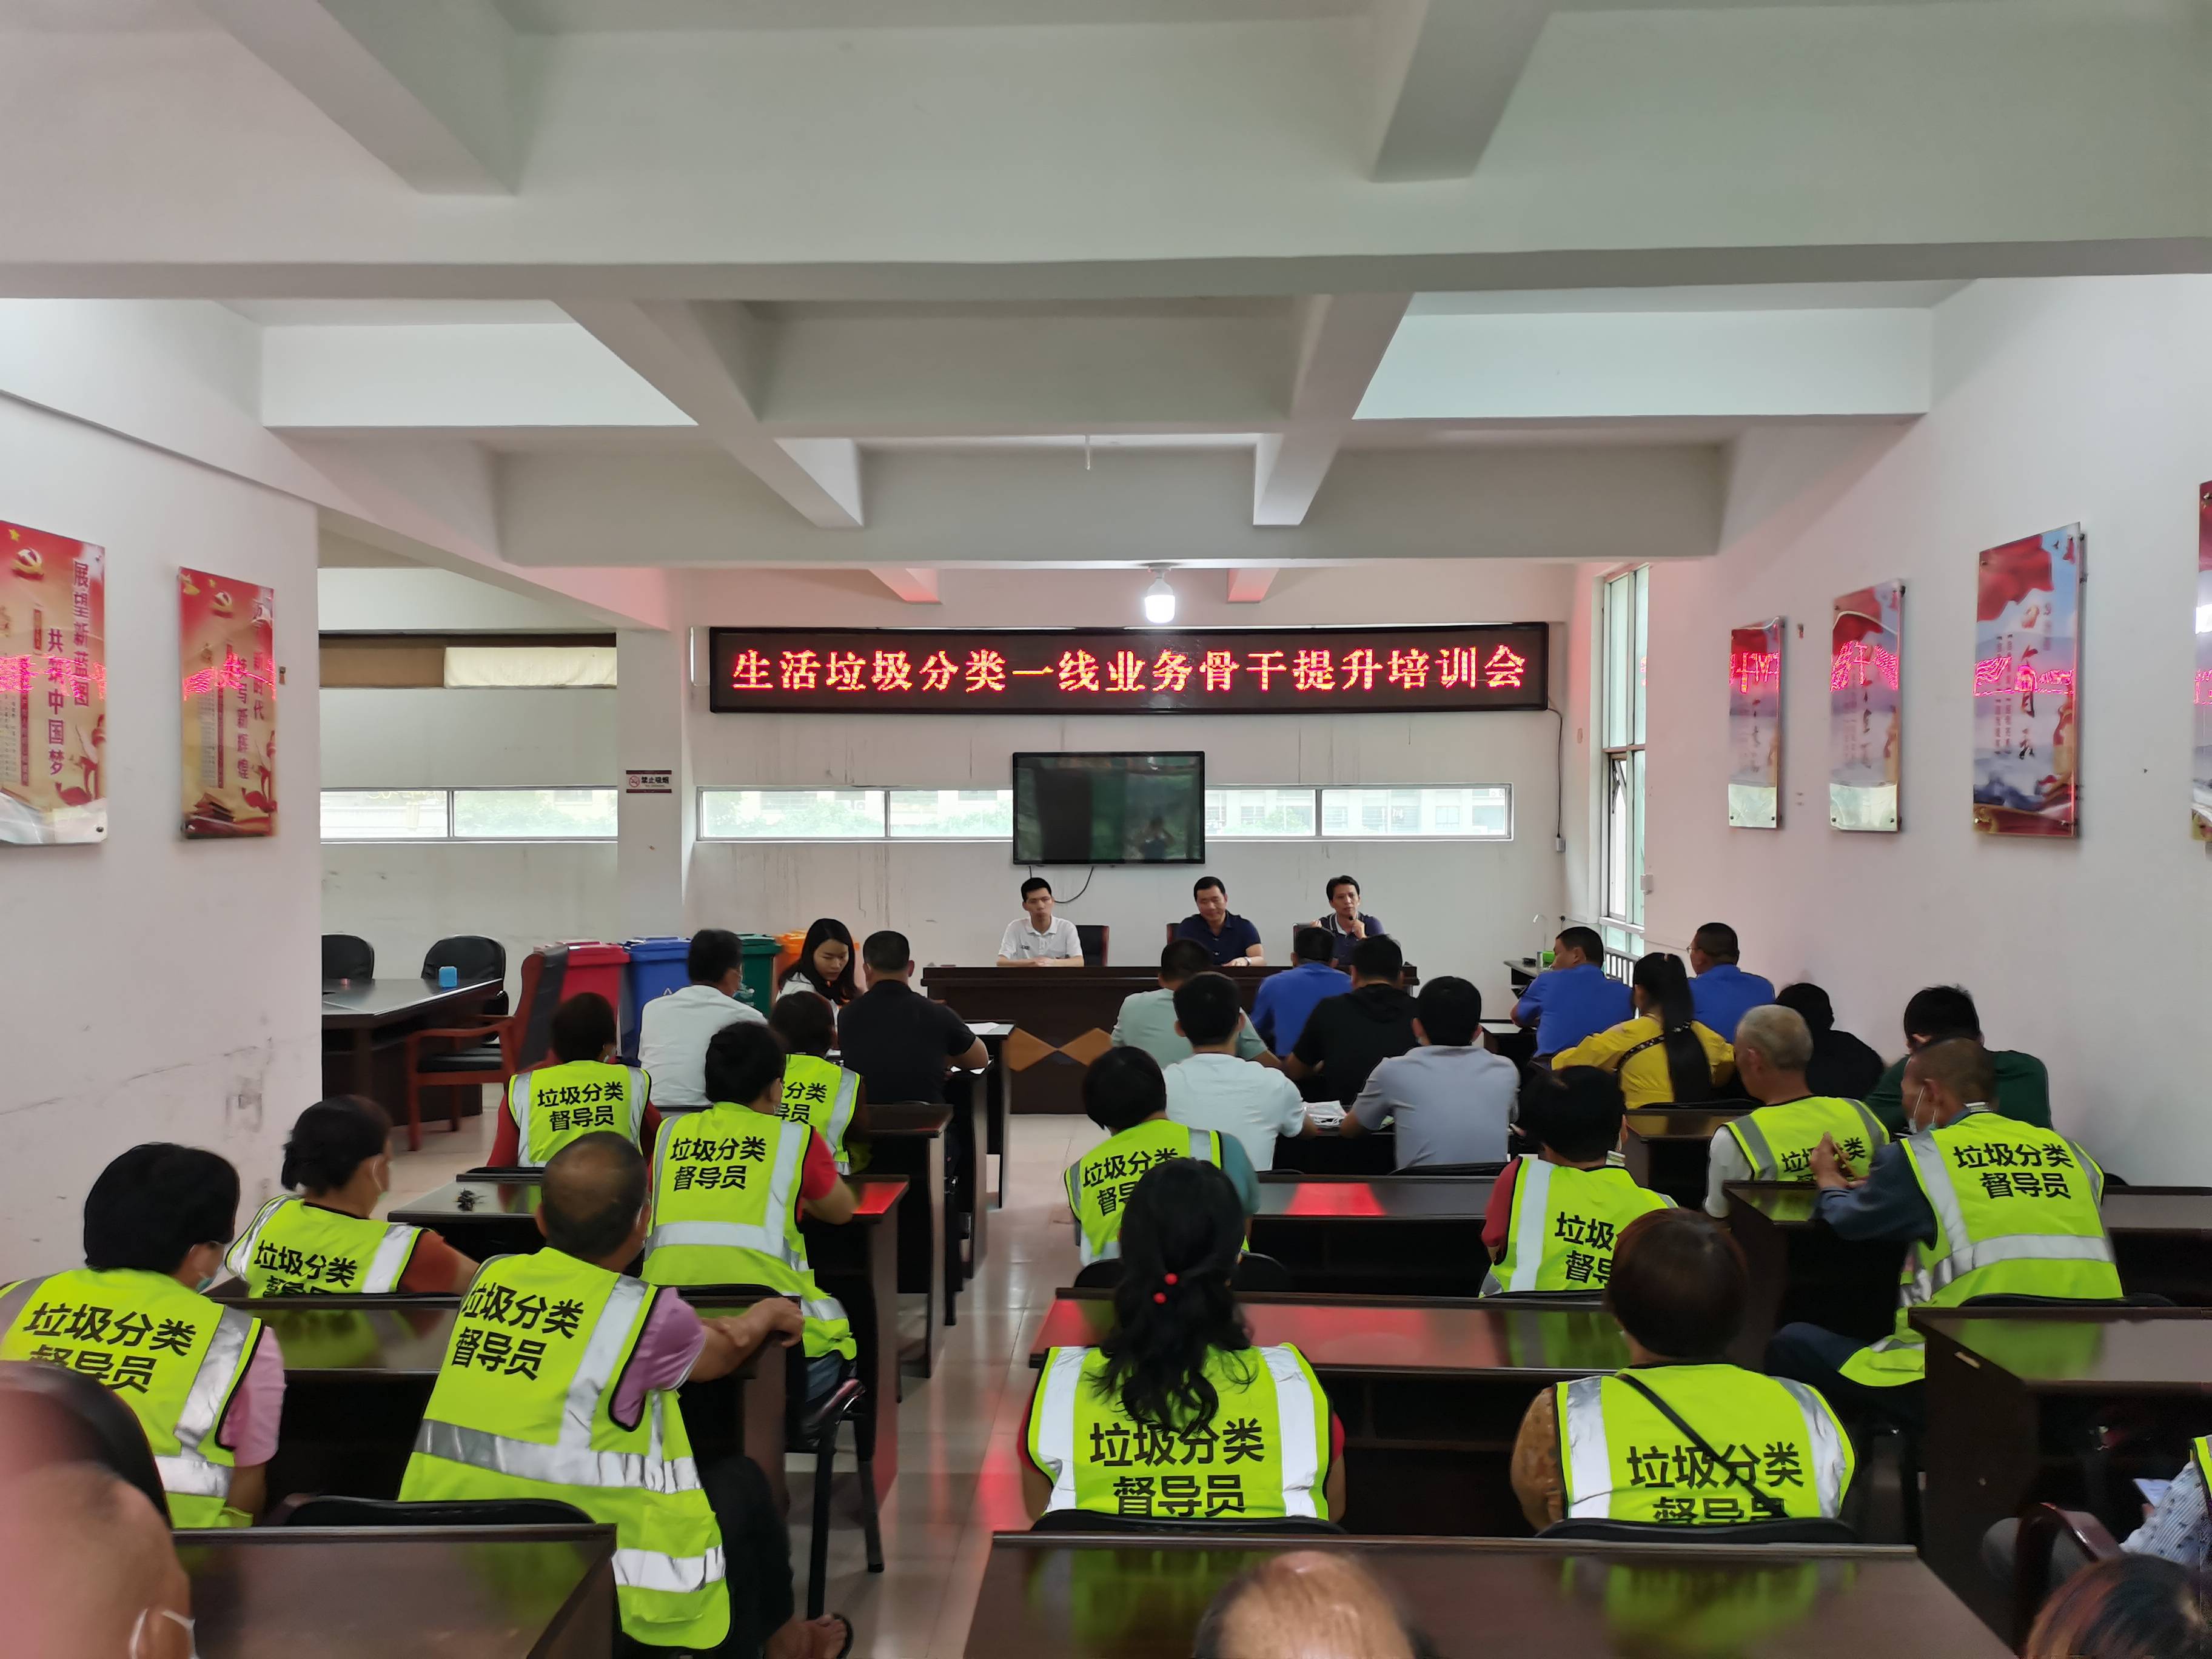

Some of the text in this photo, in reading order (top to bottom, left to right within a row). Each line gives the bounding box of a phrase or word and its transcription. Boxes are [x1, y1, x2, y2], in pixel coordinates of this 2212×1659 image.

[732, 645, 1526, 692] 生活垃圾分类一线业务骨干提升培训会
[537, 1081, 624, 1107] 垃圾分类
[783, 1081, 827, 1104] 分类
[549, 1105, 615, 1131] 督导员
[774, 1103, 811, 1125] 导员
[669, 1135, 767, 1162] 垃圾分类
[1780, 1137, 1866, 1173] 垃类
[1953, 1142, 2074, 1168] 垃圾分类
[673, 1165, 747, 1191] 督导员
[1980, 1172, 2071, 1199] 督导员
[1096, 1181, 1138, 1217] 督导
[1554, 1212, 1615, 1252] 垃圾
[253, 1239, 359, 1288] 垃圾分类
[1565, 1250, 1614, 1285] 督导
[462, 1282, 585, 1339] 垃圾分类
[23, 1302, 196, 1356] 垃圾分类
[451, 1326, 547, 1381] 督导员
[1089, 1417, 1265, 1467] 垃圾分类
[1626, 1441, 1804, 1489] 垃圾分类
[1112, 1474, 1247, 1518] 督导员
